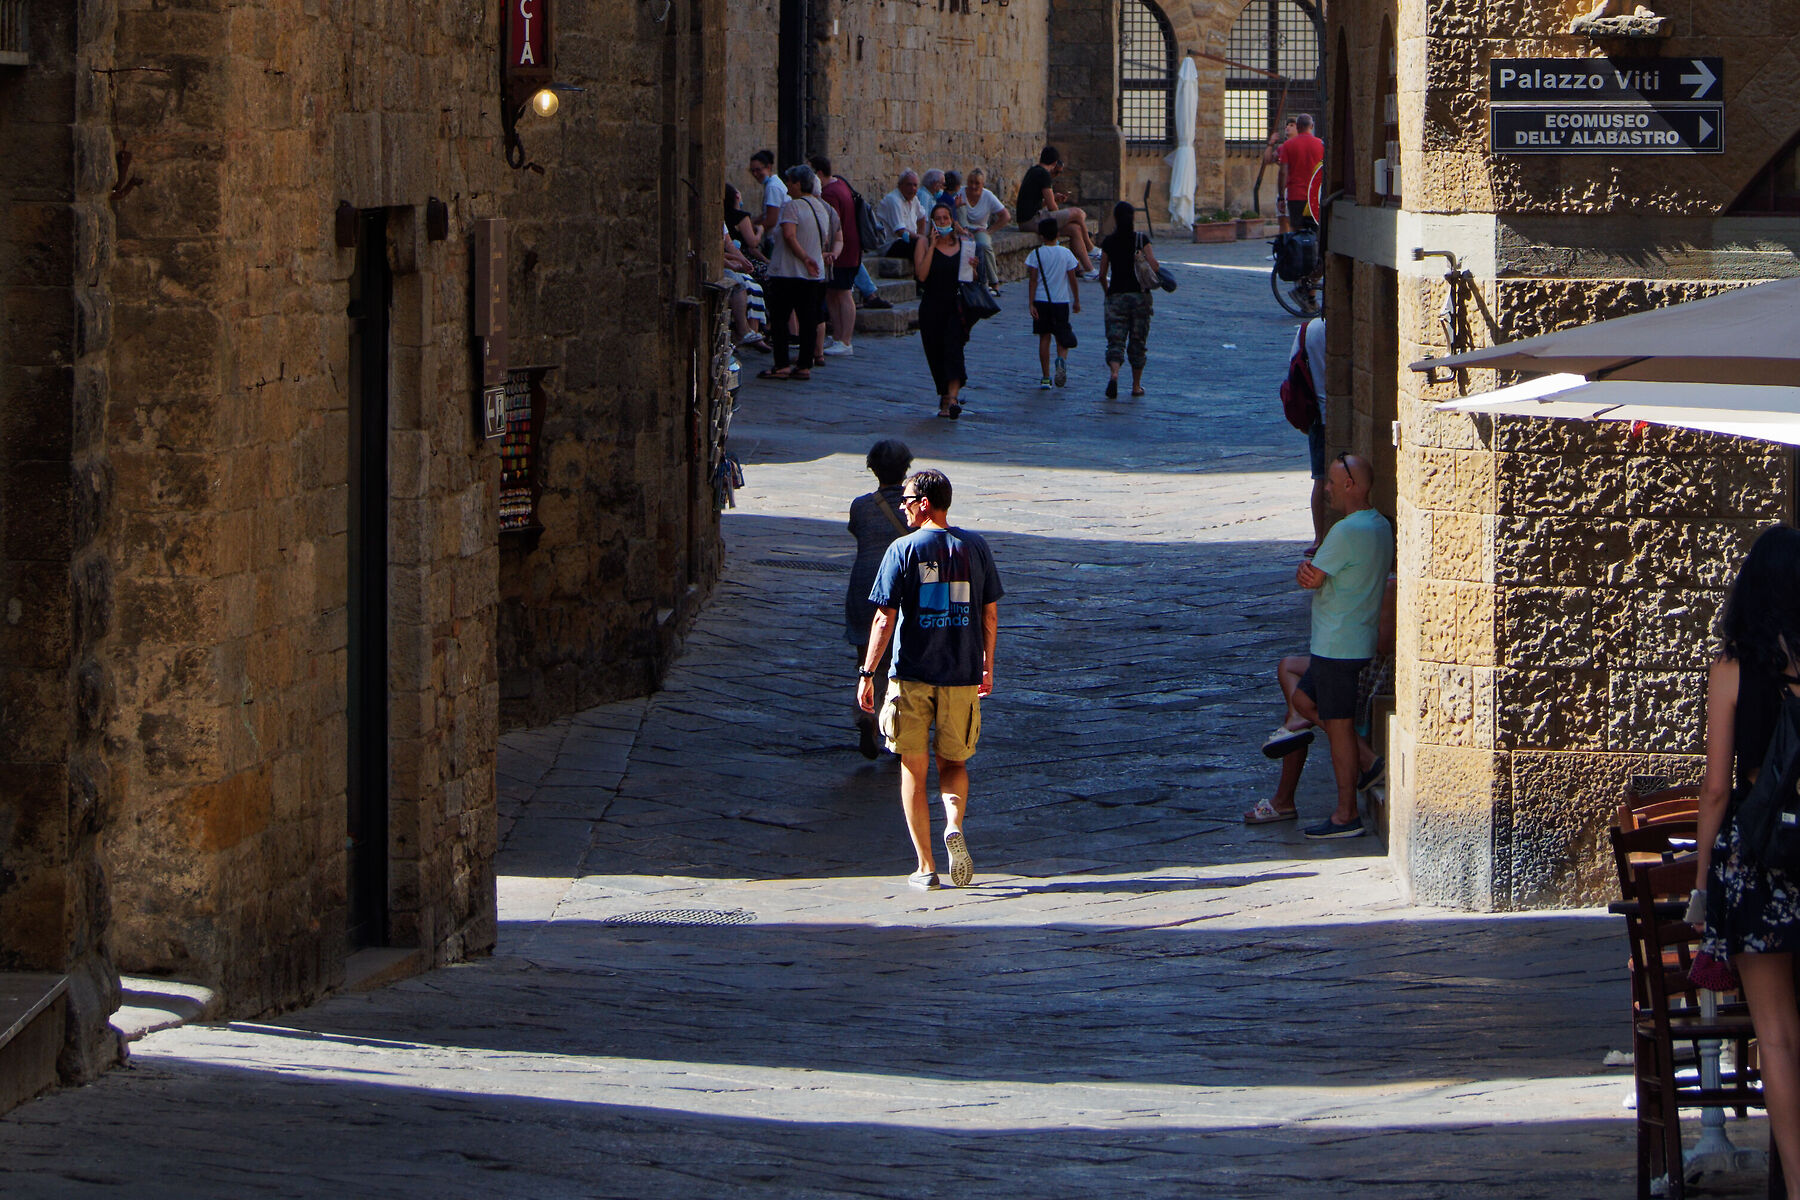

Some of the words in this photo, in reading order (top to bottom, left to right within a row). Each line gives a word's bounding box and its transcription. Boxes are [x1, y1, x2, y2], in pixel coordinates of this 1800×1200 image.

[1499, 68, 1604, 90] Palazzo
[1614, 69, 1660, 90] Viti
[1545, 114, 1649, 128] ECOMUSEO
[1515, 130, 1565, 145] DELL'
[1570, 130, 1680, 145] ALABASTRO
[919, 614, 970, 628] Grande
